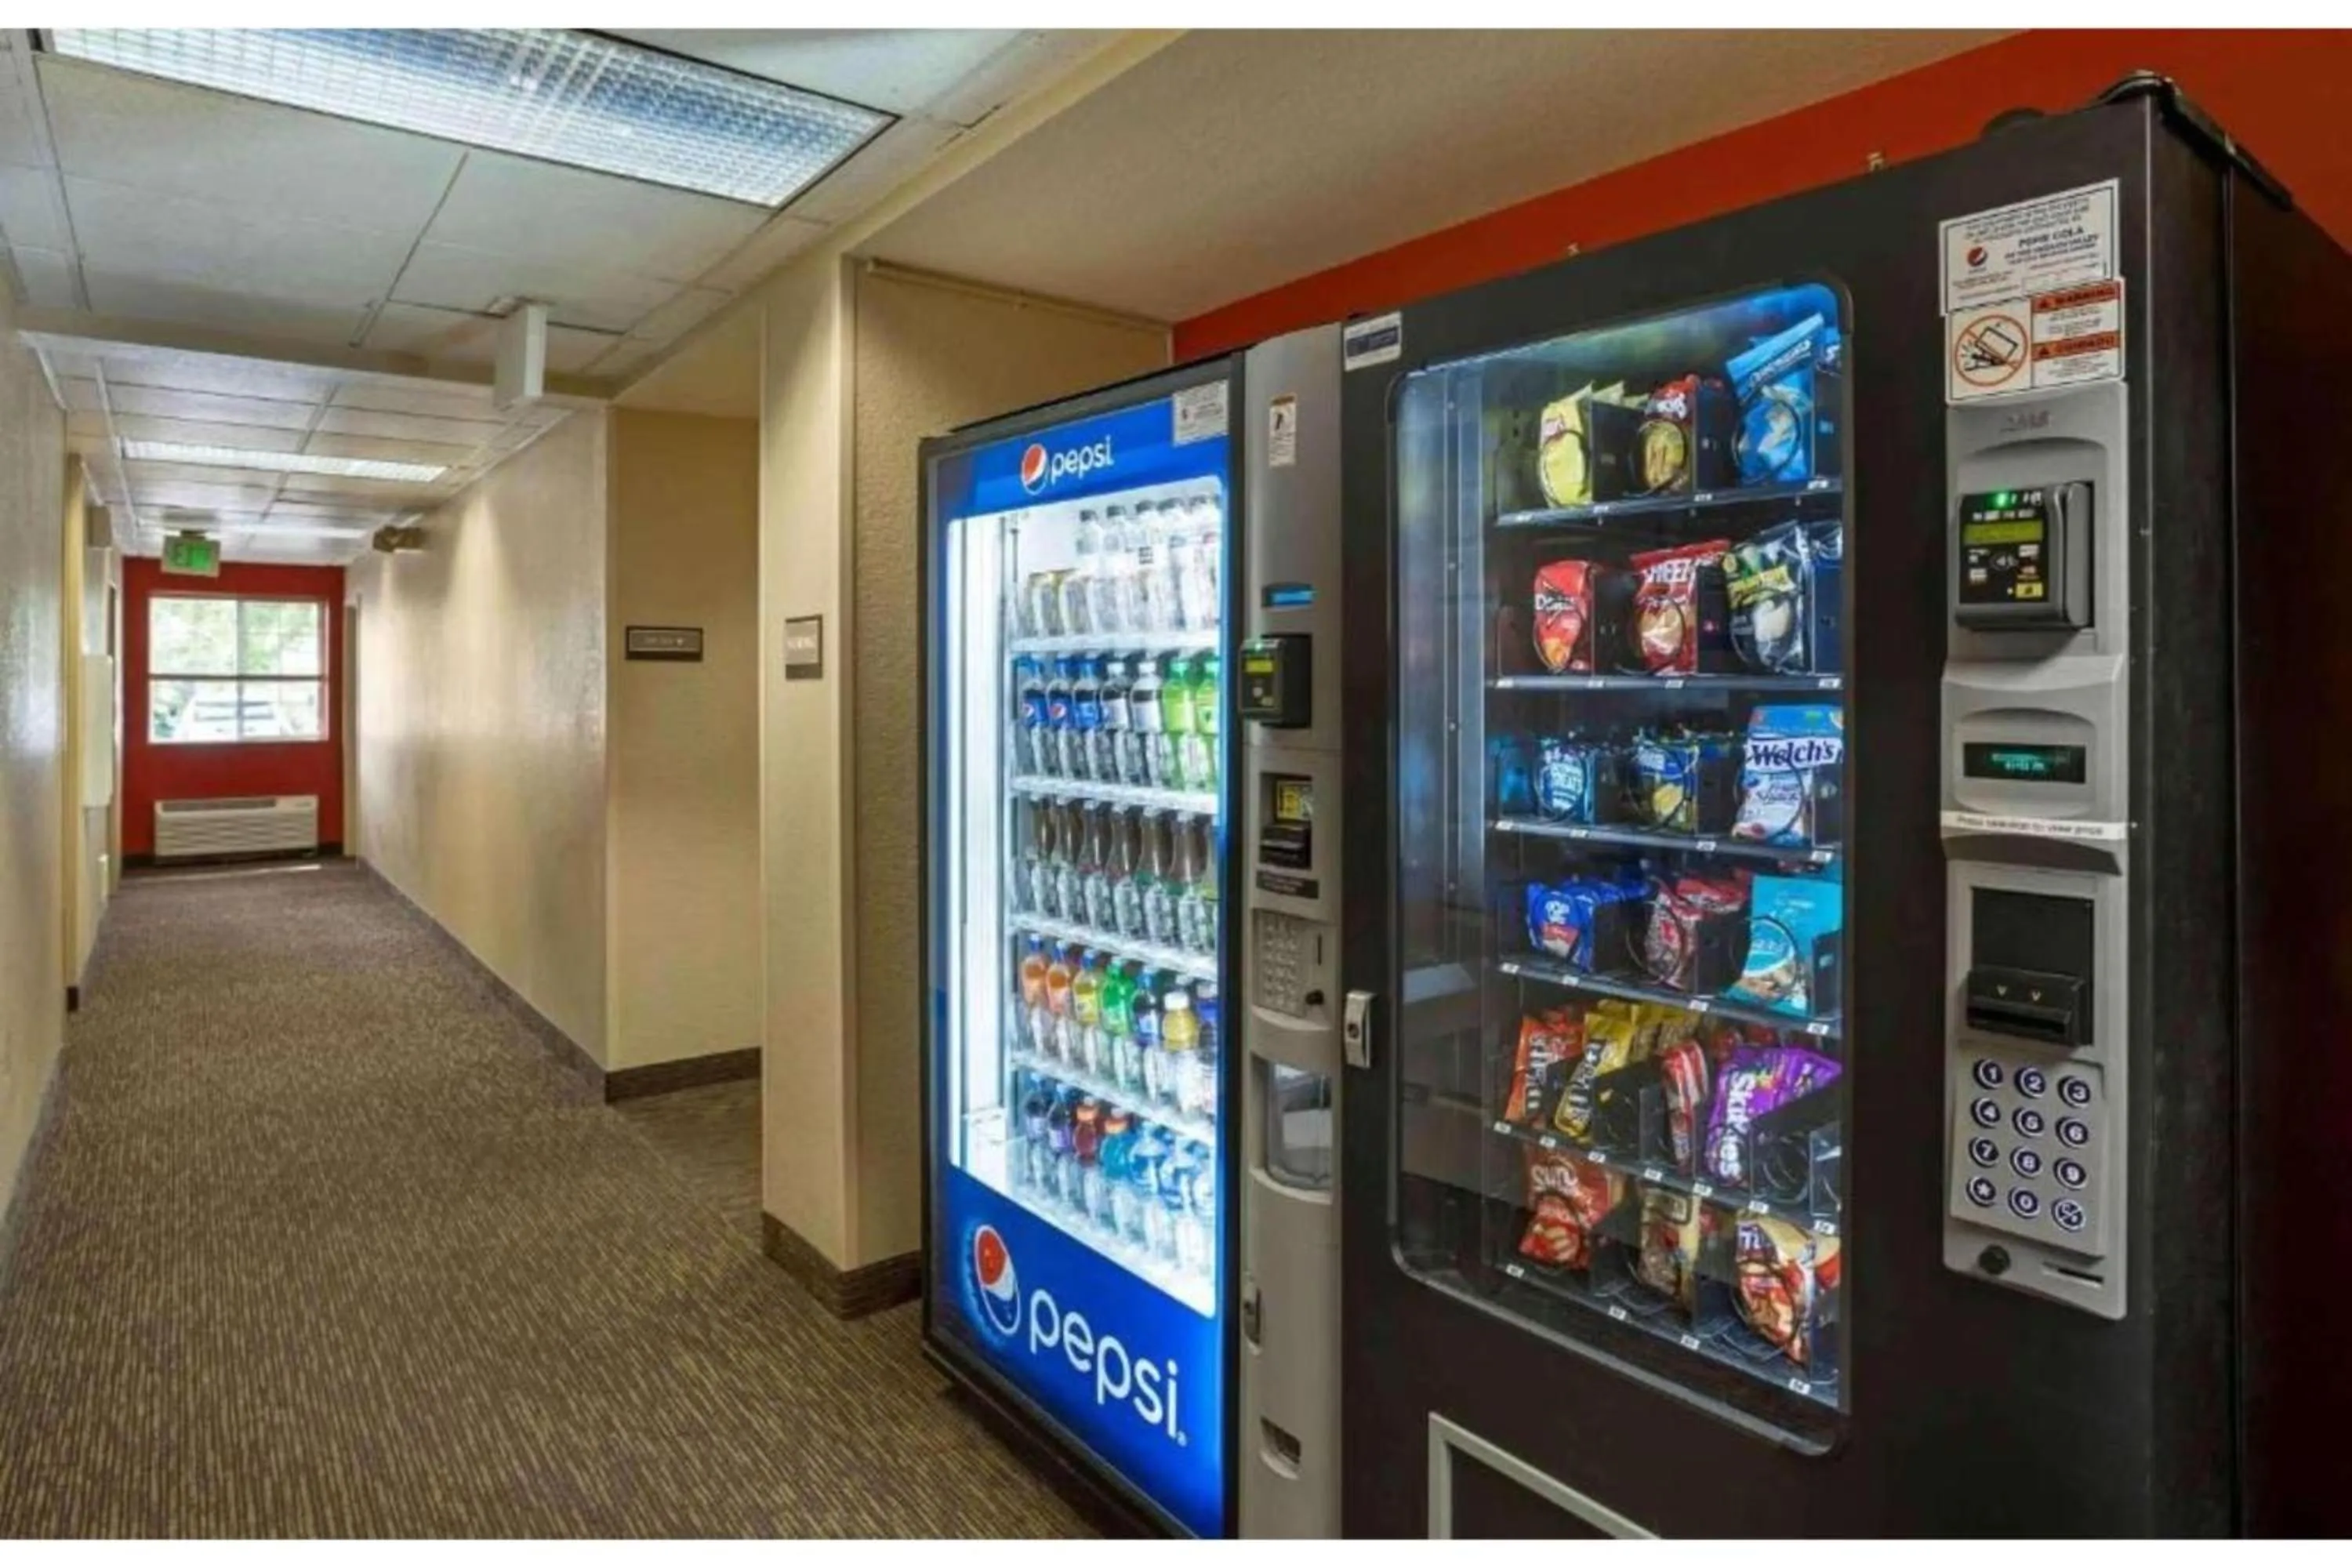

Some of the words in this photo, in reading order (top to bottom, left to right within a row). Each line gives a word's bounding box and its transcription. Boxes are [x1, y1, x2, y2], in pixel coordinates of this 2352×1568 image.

[1050, 434, 1114, 485] pepsi
[1751, 740, 1835, 767] Welch's
[1029, 1289, 1178, 1439] pepsi
